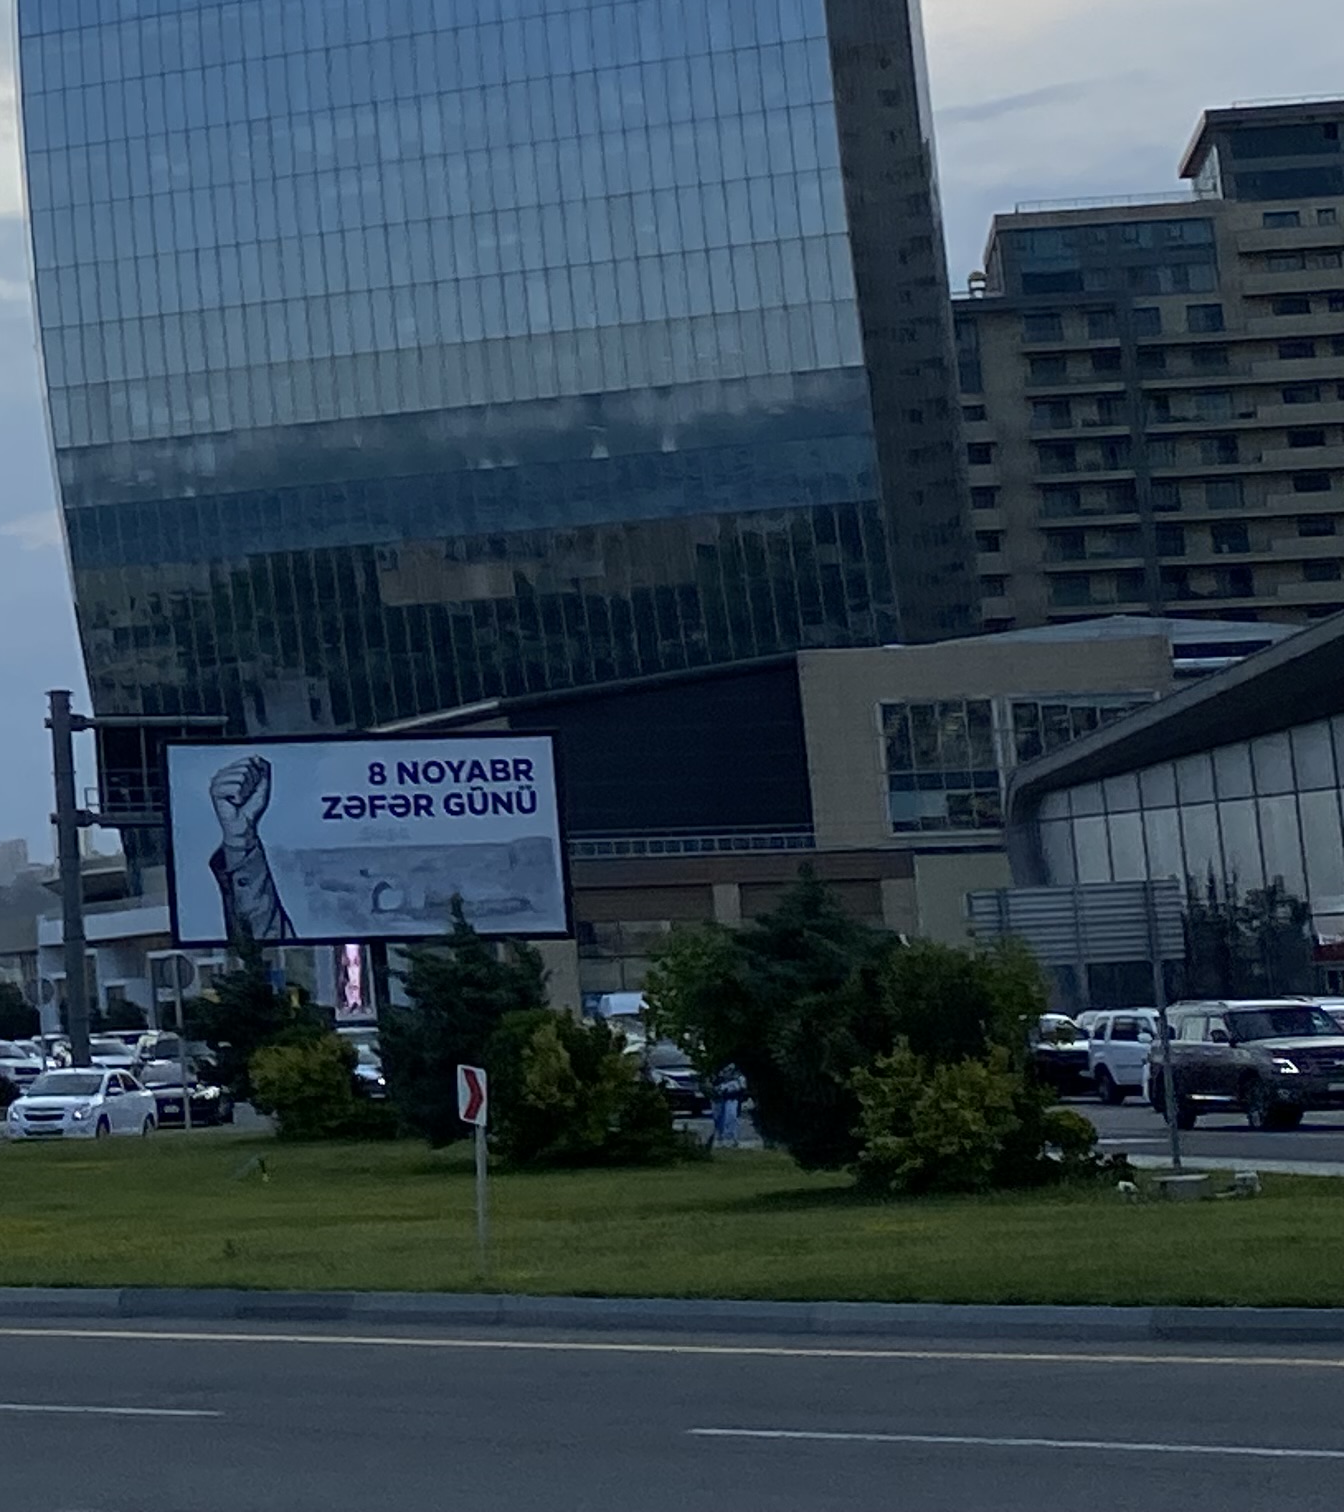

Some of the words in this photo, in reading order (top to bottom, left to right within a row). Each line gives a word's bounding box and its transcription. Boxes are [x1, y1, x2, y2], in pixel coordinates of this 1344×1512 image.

[368, 762, 387, 786] 8
[397, 759, 534, 786] NOYABR
[322, 793, 436, 819] ZƏFƏR
[444, 785, 537, 817] GÜNÜ
